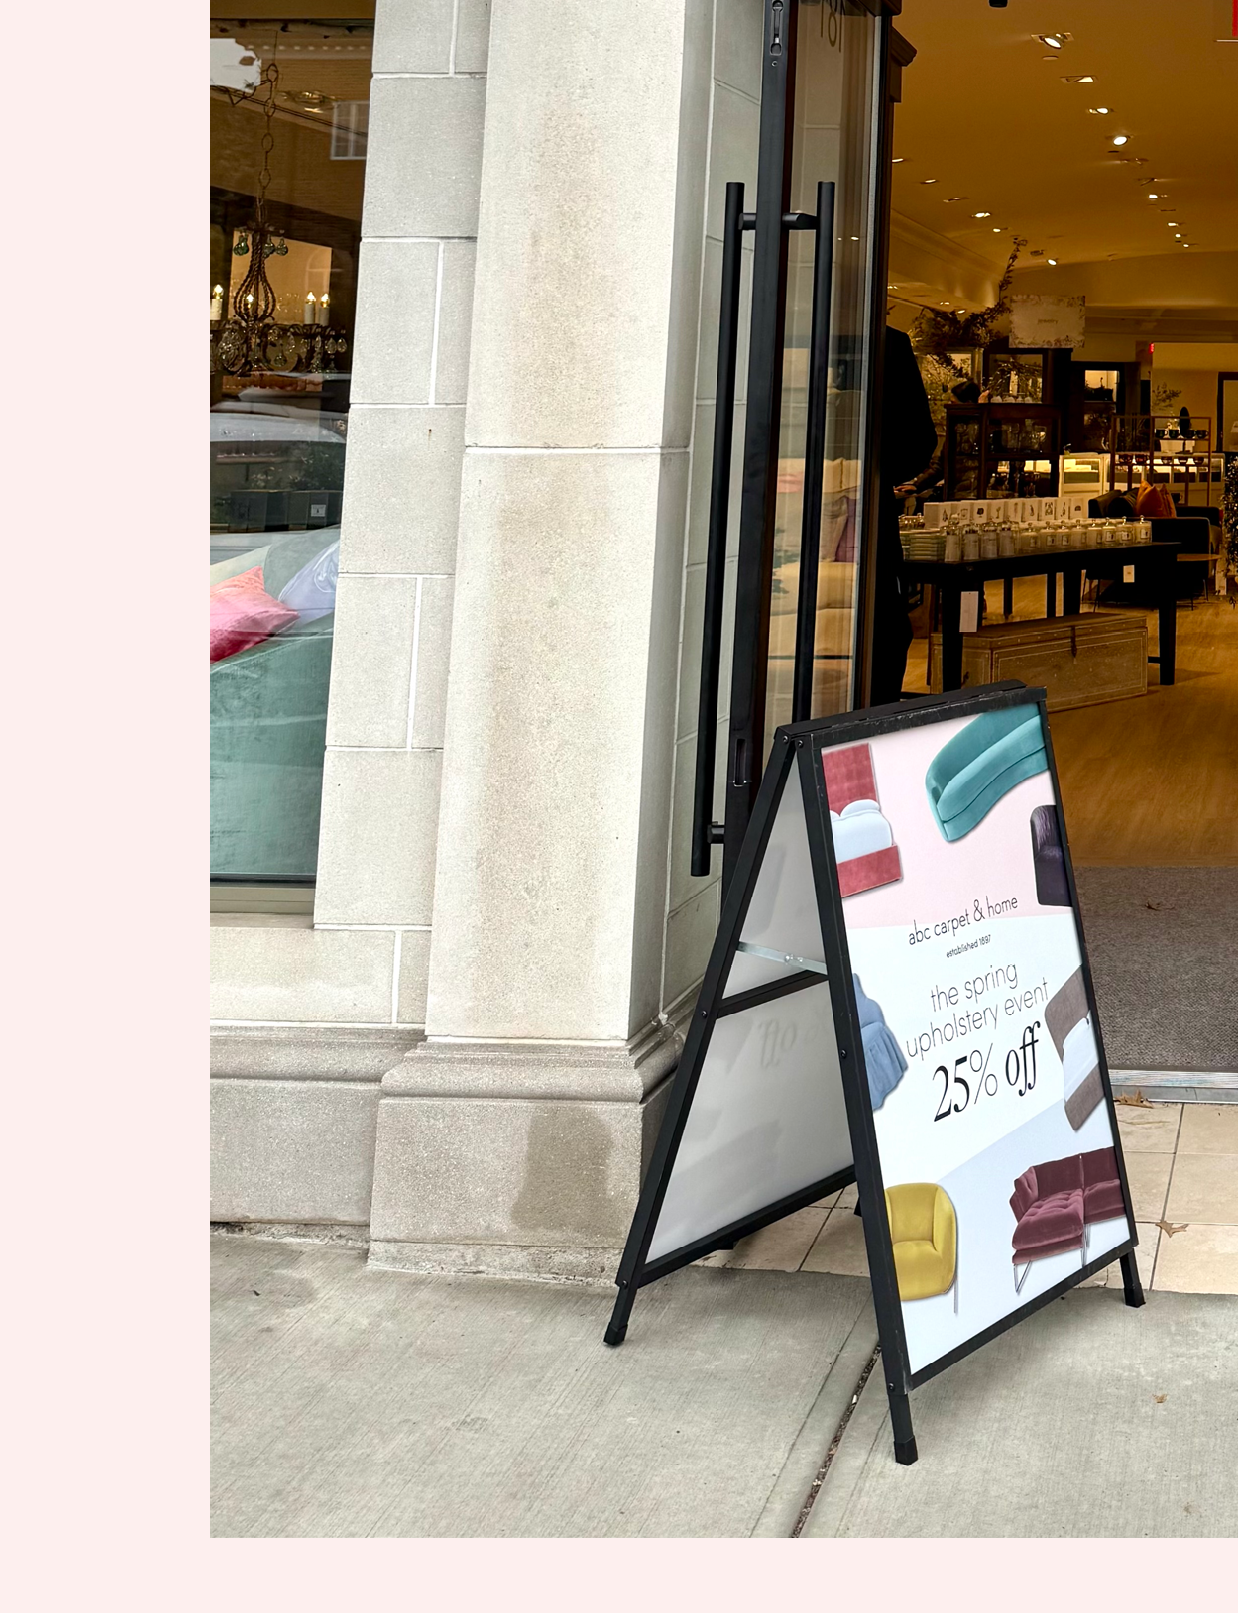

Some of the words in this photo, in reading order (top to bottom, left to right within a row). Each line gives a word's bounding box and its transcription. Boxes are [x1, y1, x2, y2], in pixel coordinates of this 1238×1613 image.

[908, 920, 932, 946] abc
[934, 909, 971, 937] carpet
[973, 899, 987, 923] &
[986, 896, 1019, 917] home
[946, 939, 979, 958] established
[931, 985, 960, 1013] the
[964, 962, 1018, 996] spring
[906, 1004, 1000, 1061] upholstery
[1004, 977, 1050, 1016] event
[932, 1042, 998, 1123] 25%
[1005, 1020, 1042, 1097] off
